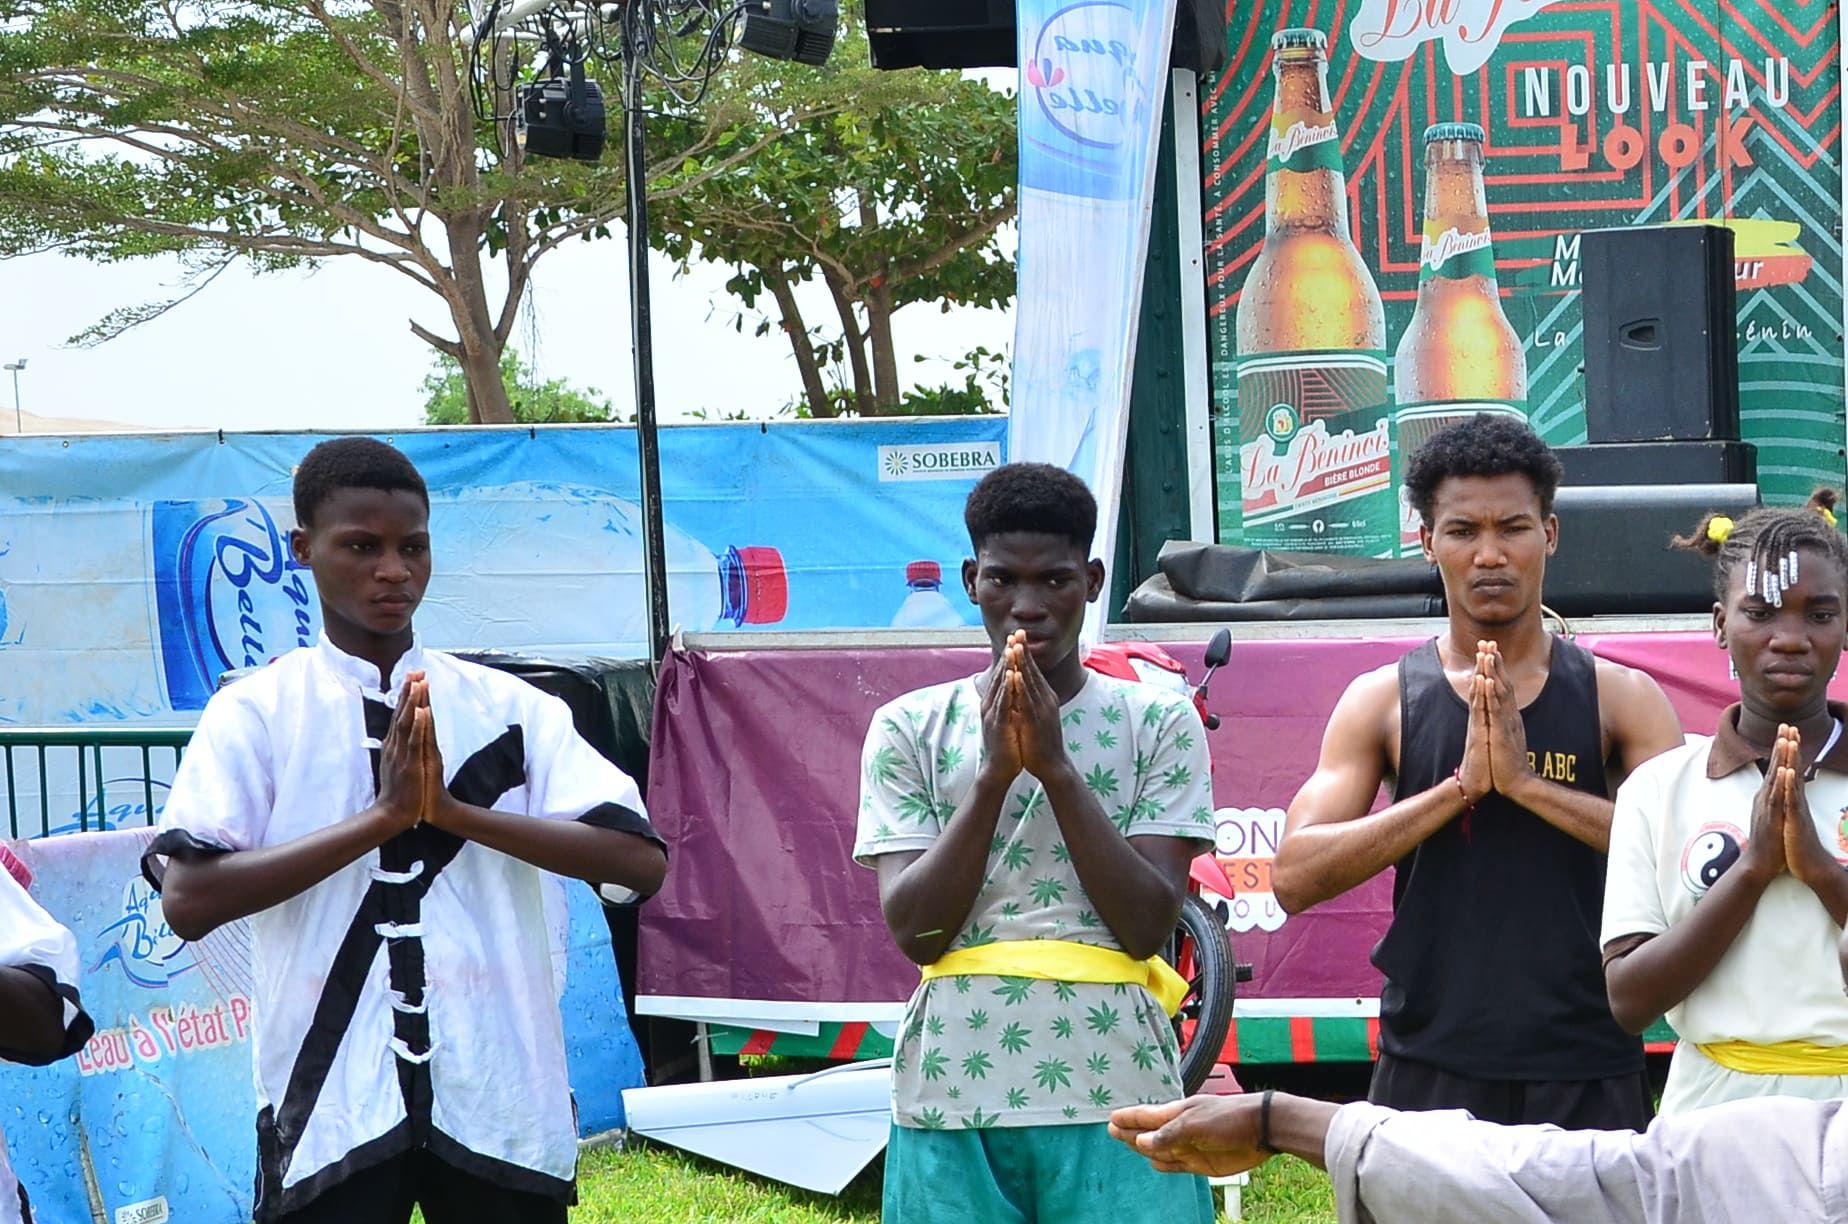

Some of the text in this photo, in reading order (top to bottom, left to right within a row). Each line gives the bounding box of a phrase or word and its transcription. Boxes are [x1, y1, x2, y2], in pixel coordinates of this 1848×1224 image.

[1209, 86, 1218, 113] AVEC
[1524, 57, 1789, 116] NOUVEAU
[1211, 118, 1221, 185] CONSOMMER
[1560, 117, 1754, 170] LOOK
[1215, 243, 1224, 255] LA
[1216, 260, 1225, 288] POUR
[1217, 292, 1229, 356] DANGEREUX
[1534, 319, 1813, 347] La énin
[912, 451, 996, 469] SOBEBRA
[1349, 461, 1381, 483] BLONDE
